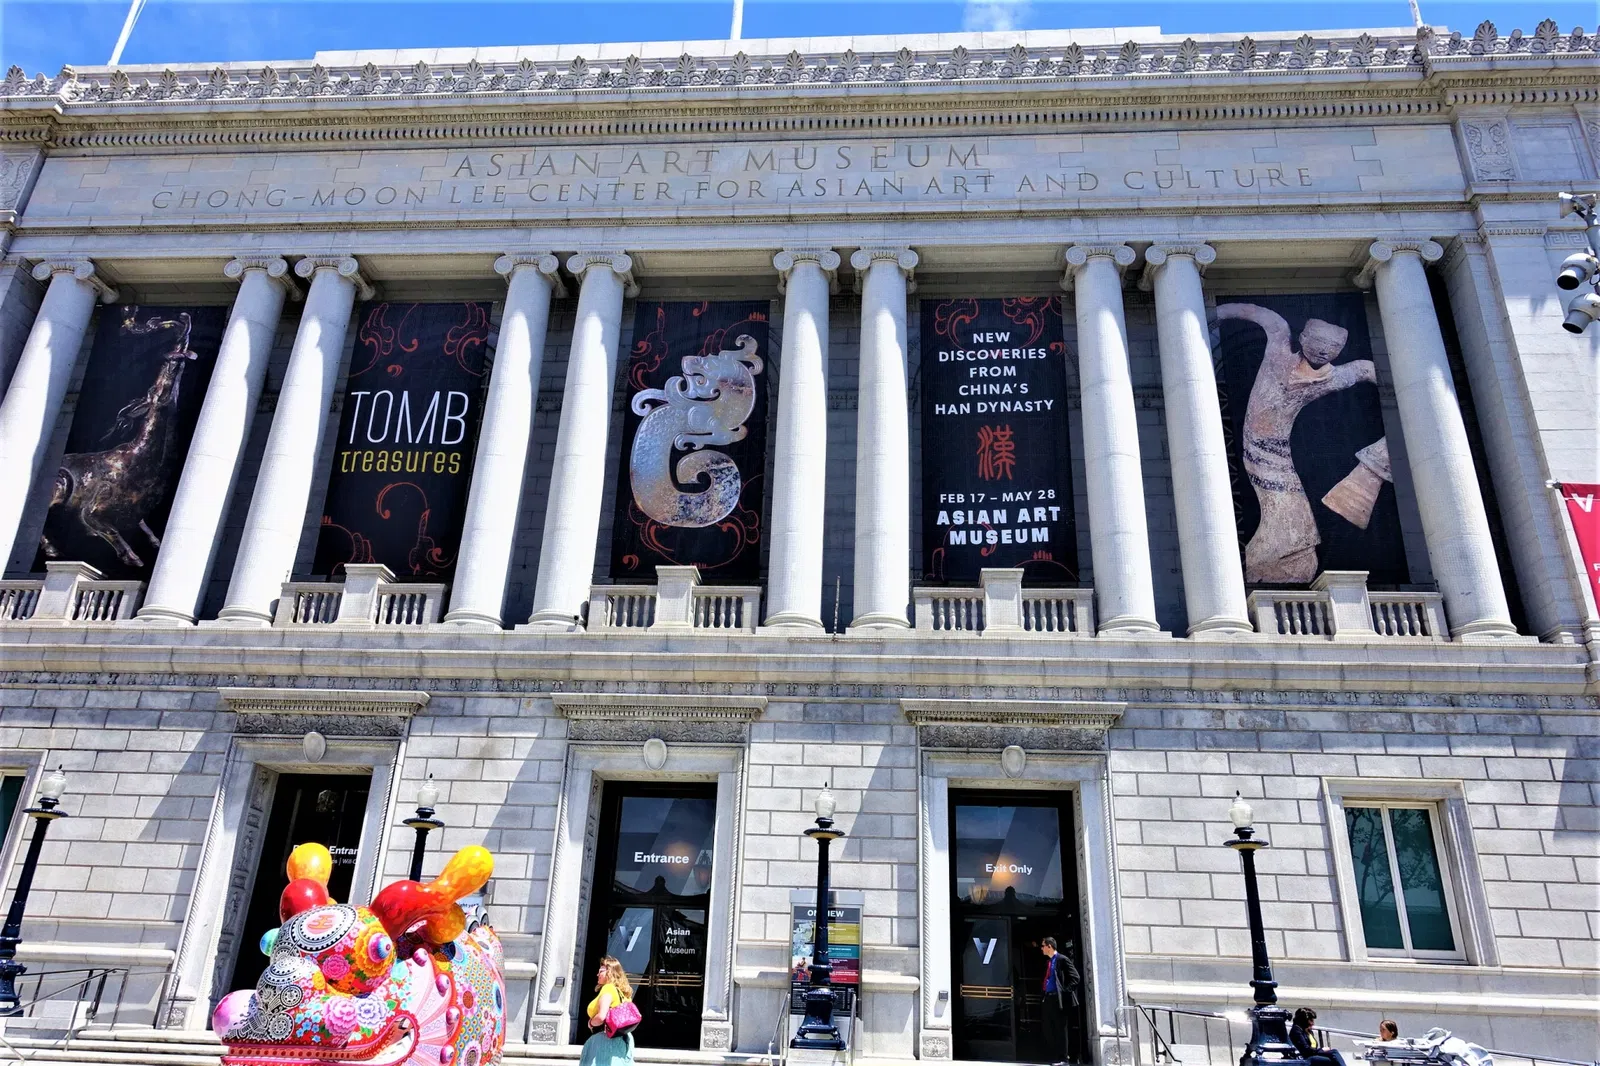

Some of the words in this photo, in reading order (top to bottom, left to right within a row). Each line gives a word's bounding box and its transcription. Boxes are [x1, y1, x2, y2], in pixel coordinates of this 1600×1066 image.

[452, 151, 599, 177] ASIAN
[624, 150, 719, 175] ART
[743, 143, 982, 172] MUSEUM
[152, 186, 427, 209] CHONG-MOON
[448, 185, 506, 204] LEE
[528, 182, 673, 202] CENTER
[696, 180, 766, 199] FOR
[787, 177, 904, 197] ASIAN
[923, 174, 995, 194] ART
[1016, 171, 1099, 193] AND
[1123, 167, 1313, 190] CULTURE
[973, 332, 1011, 344] NEW
[938, 348, 1047, 362] DISCOVERIES
[969, 365, 1017, 378] FROM
[958, 383, 1029, 396] CHINA'S
[935, 403, 971, 415] HAN
[977, 399, 1054, 413] DYNASTY
[349, 390, 470, 445] TOMB
[341, 450, 461, 474] treasures
[940, 493, 965, 503] FEB
[970, 493, 986, 503] 17
[1002, 491, 1033, 502] MAY
[1037, 489, 1056, 500] 28
[936, 509, 1008, 526] ASIAN
[1017, 506, 1061, 523] ART
[950, 527, 1049, 546] MUSEUM
[634, 851, 690, 864] Entrance
[985, 863, 1007, 873] Exit
[1009, 864, 1033, 875] Only
[666, 927, 691, 936] Asian
[665, 936, 677, 945] Art
[664, 945, 696, 955] Museum
